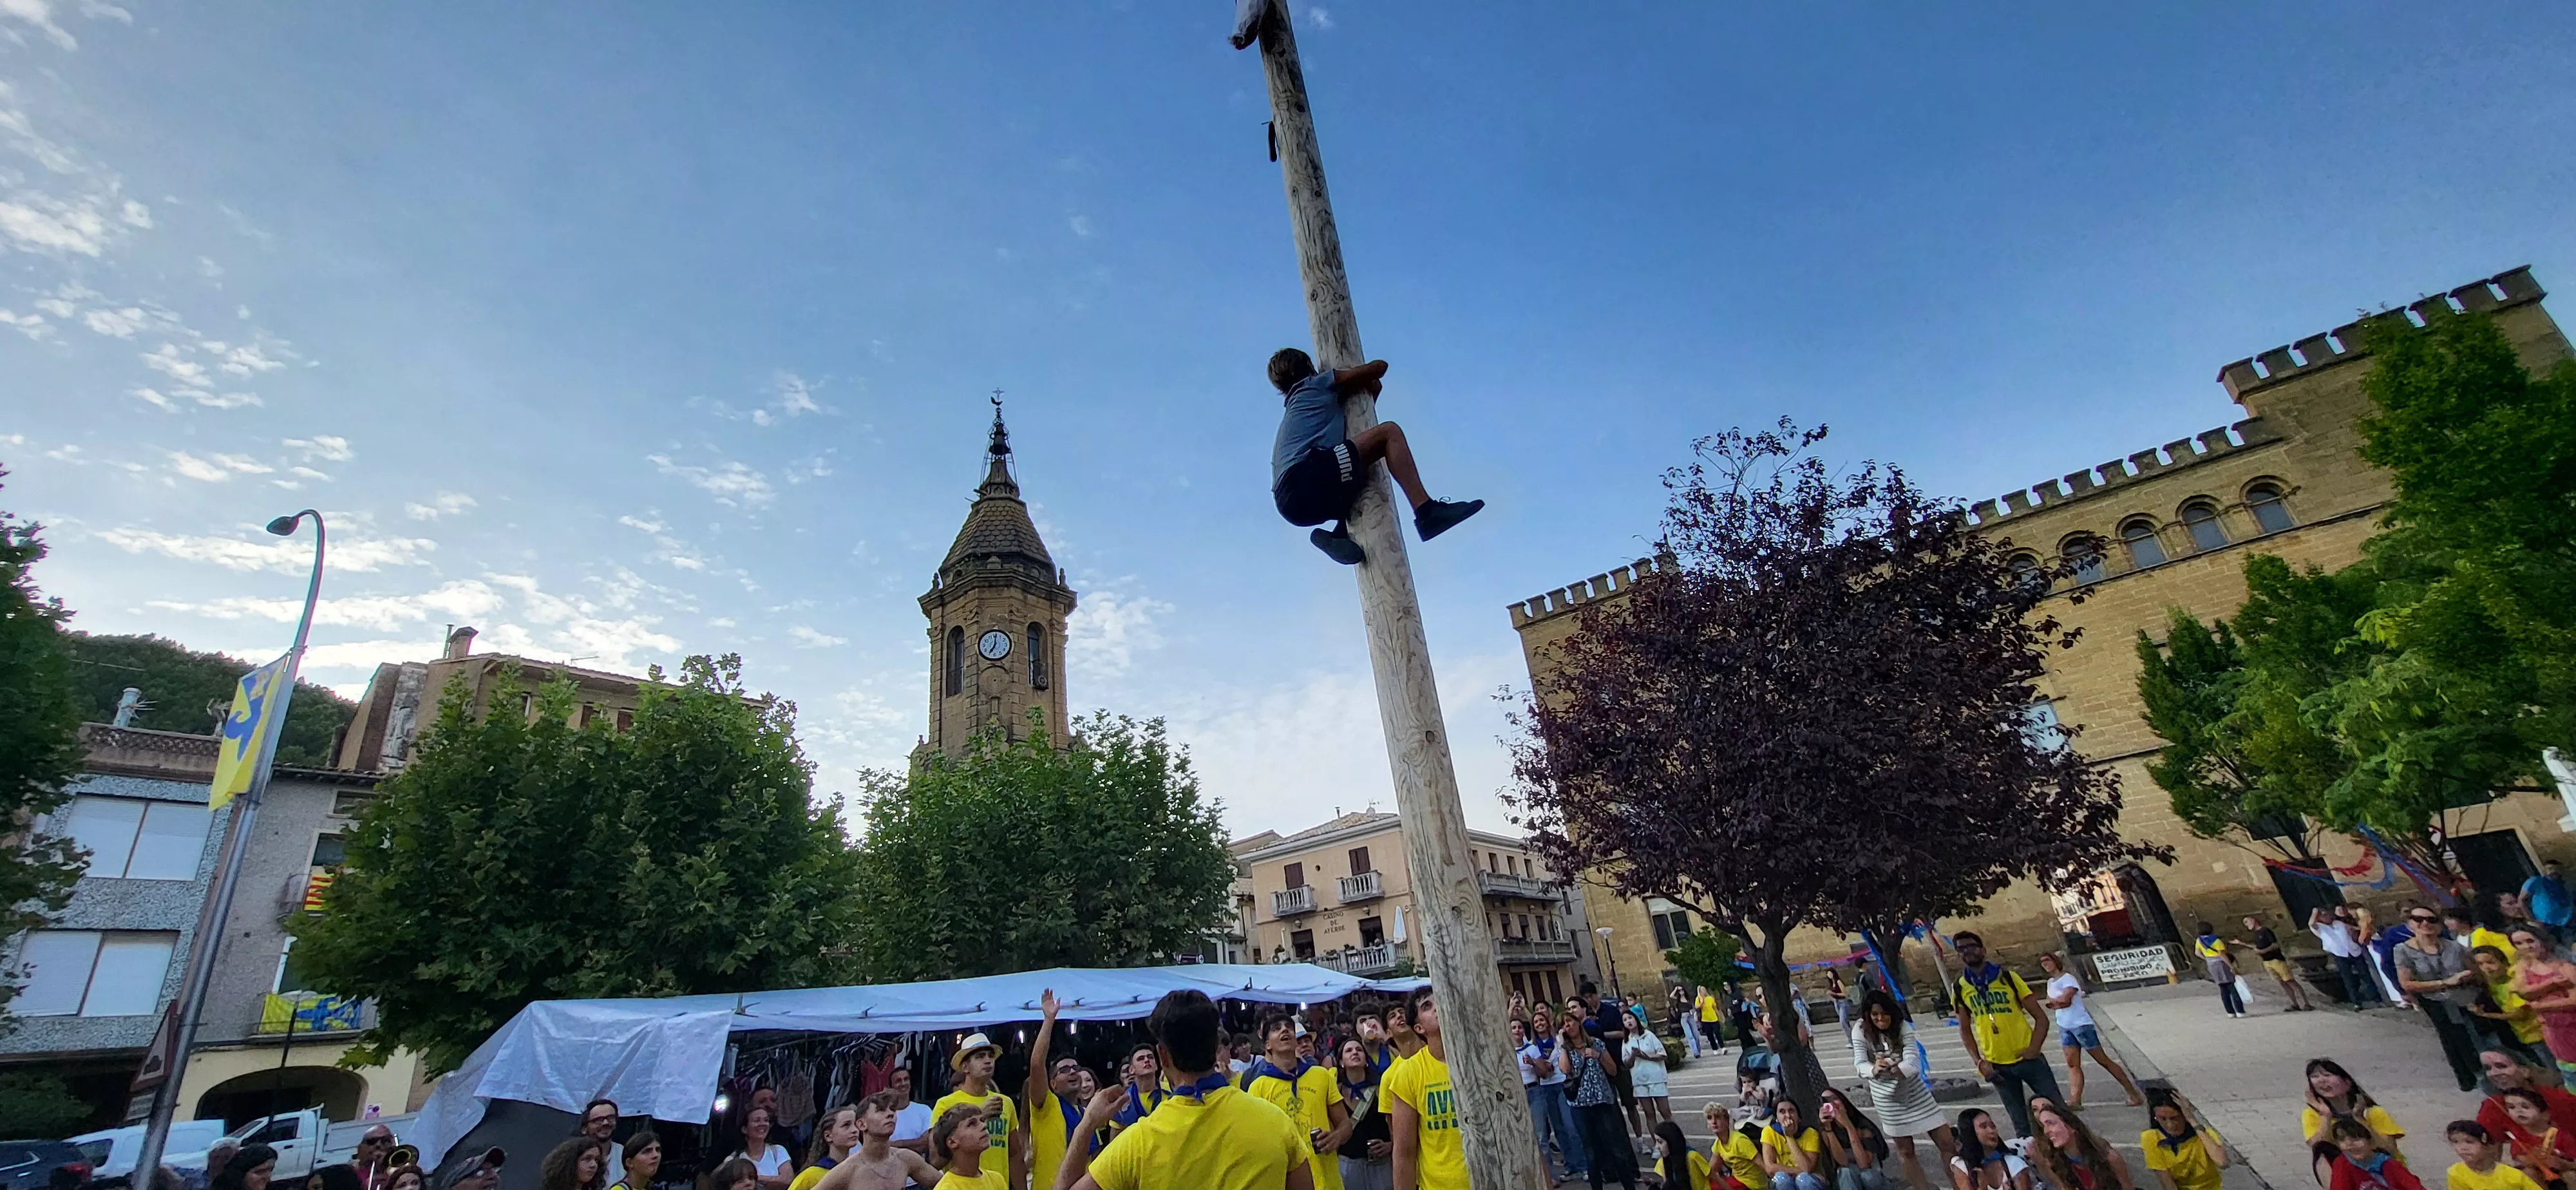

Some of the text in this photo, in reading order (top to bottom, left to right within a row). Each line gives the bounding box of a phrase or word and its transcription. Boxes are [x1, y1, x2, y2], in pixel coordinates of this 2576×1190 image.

[1333, 443, 1352, 482] PUMA
[1323, 911, 1343, 920] CASINO
[1323, 925, 1346, 934] AYERBE
[2096, 948, 2164, 963] SEGURIDAD
[2101, 963, 2153, 975] PROHIBIDO
